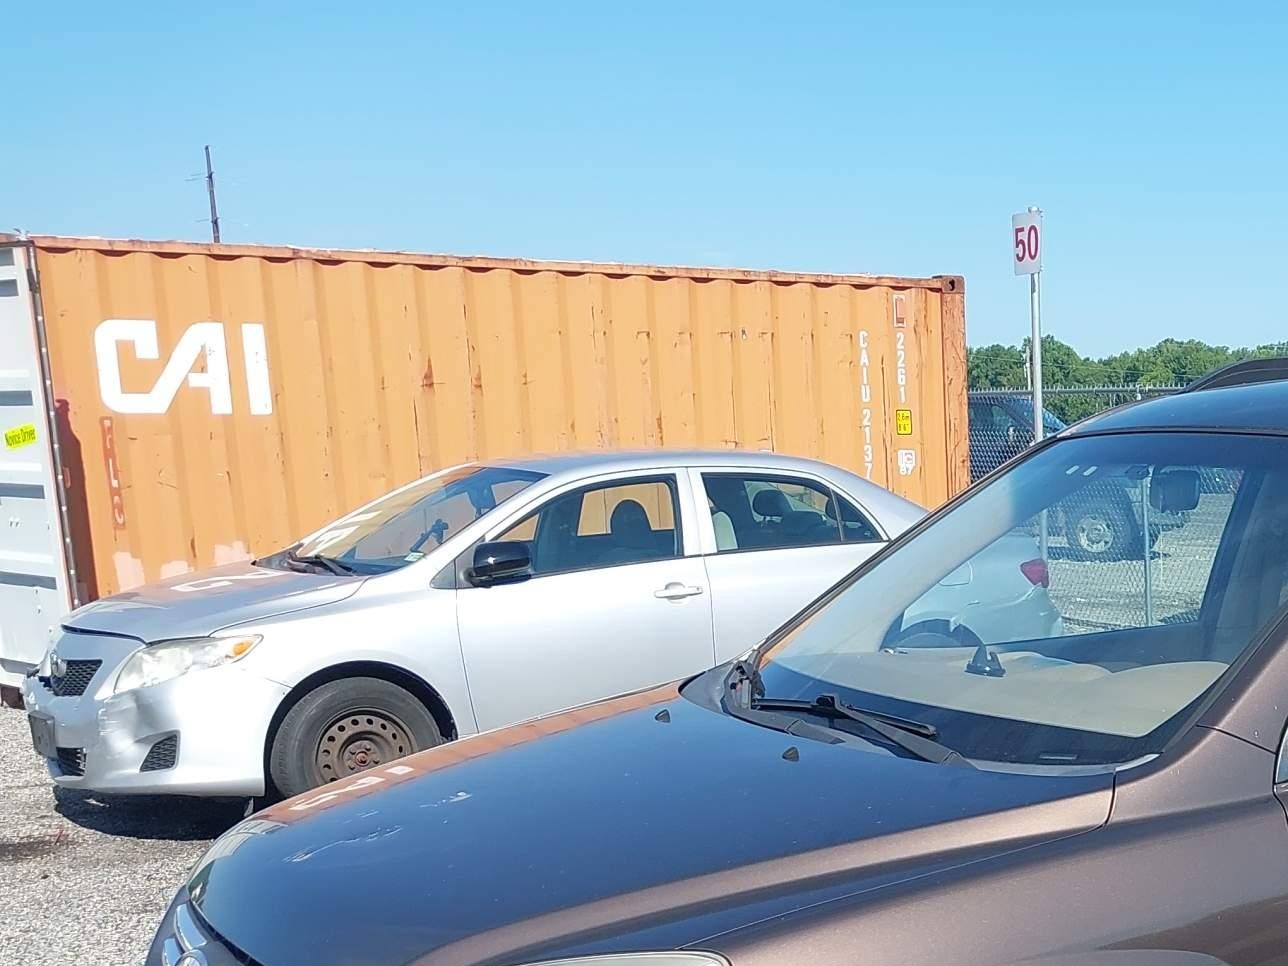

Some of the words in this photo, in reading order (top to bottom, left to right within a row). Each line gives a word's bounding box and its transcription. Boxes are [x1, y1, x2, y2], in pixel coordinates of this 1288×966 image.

[1015, 225, 1039, 262] 50
[94, 319, 273, 415] CAI
[859, 331, 870, 402] CAIU
[896, 332, 906, 403] 2261
[862, 408, 873, 479] 2137
